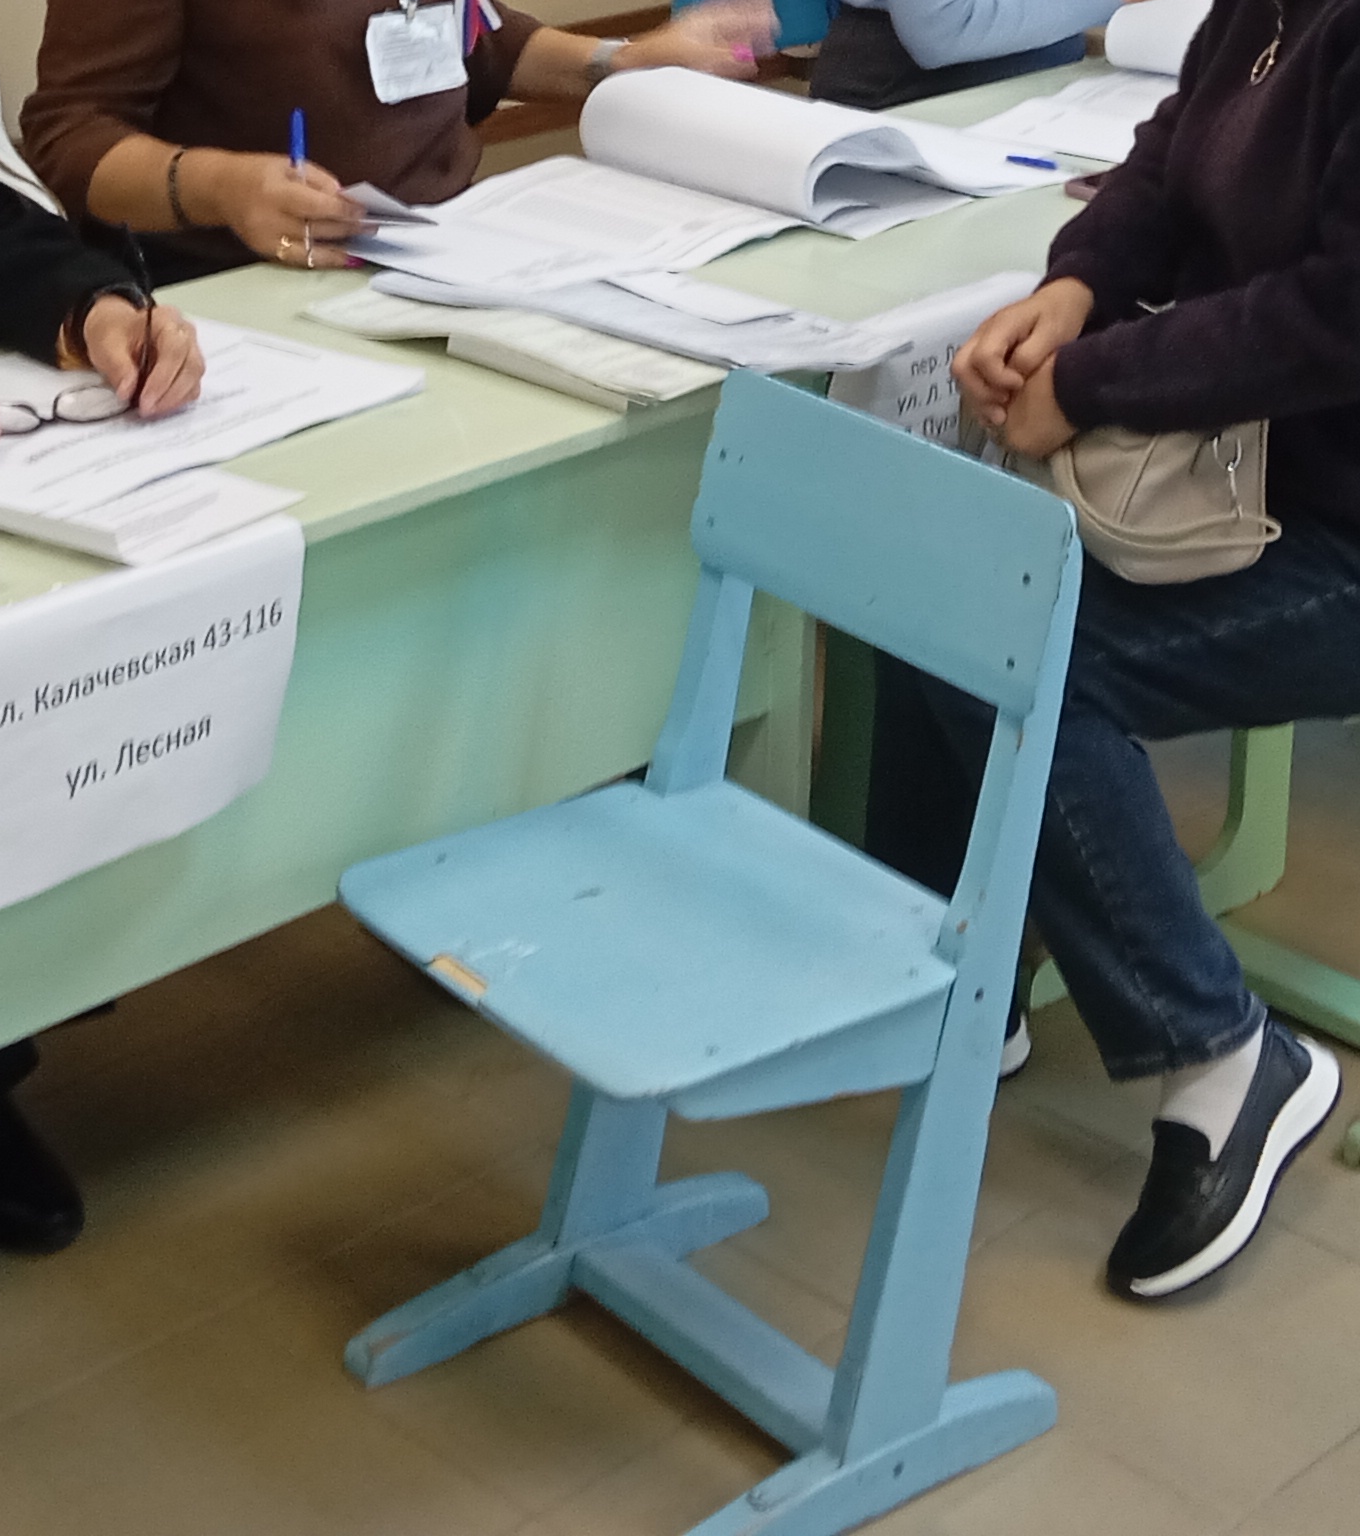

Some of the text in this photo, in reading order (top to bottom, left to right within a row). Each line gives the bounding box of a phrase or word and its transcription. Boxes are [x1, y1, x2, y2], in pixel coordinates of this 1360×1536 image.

[34, 636, 197, 715] Калачевская
[203, 596, 283, 651] 43-116
[66, 713, 213, 800] ул. Лесная
